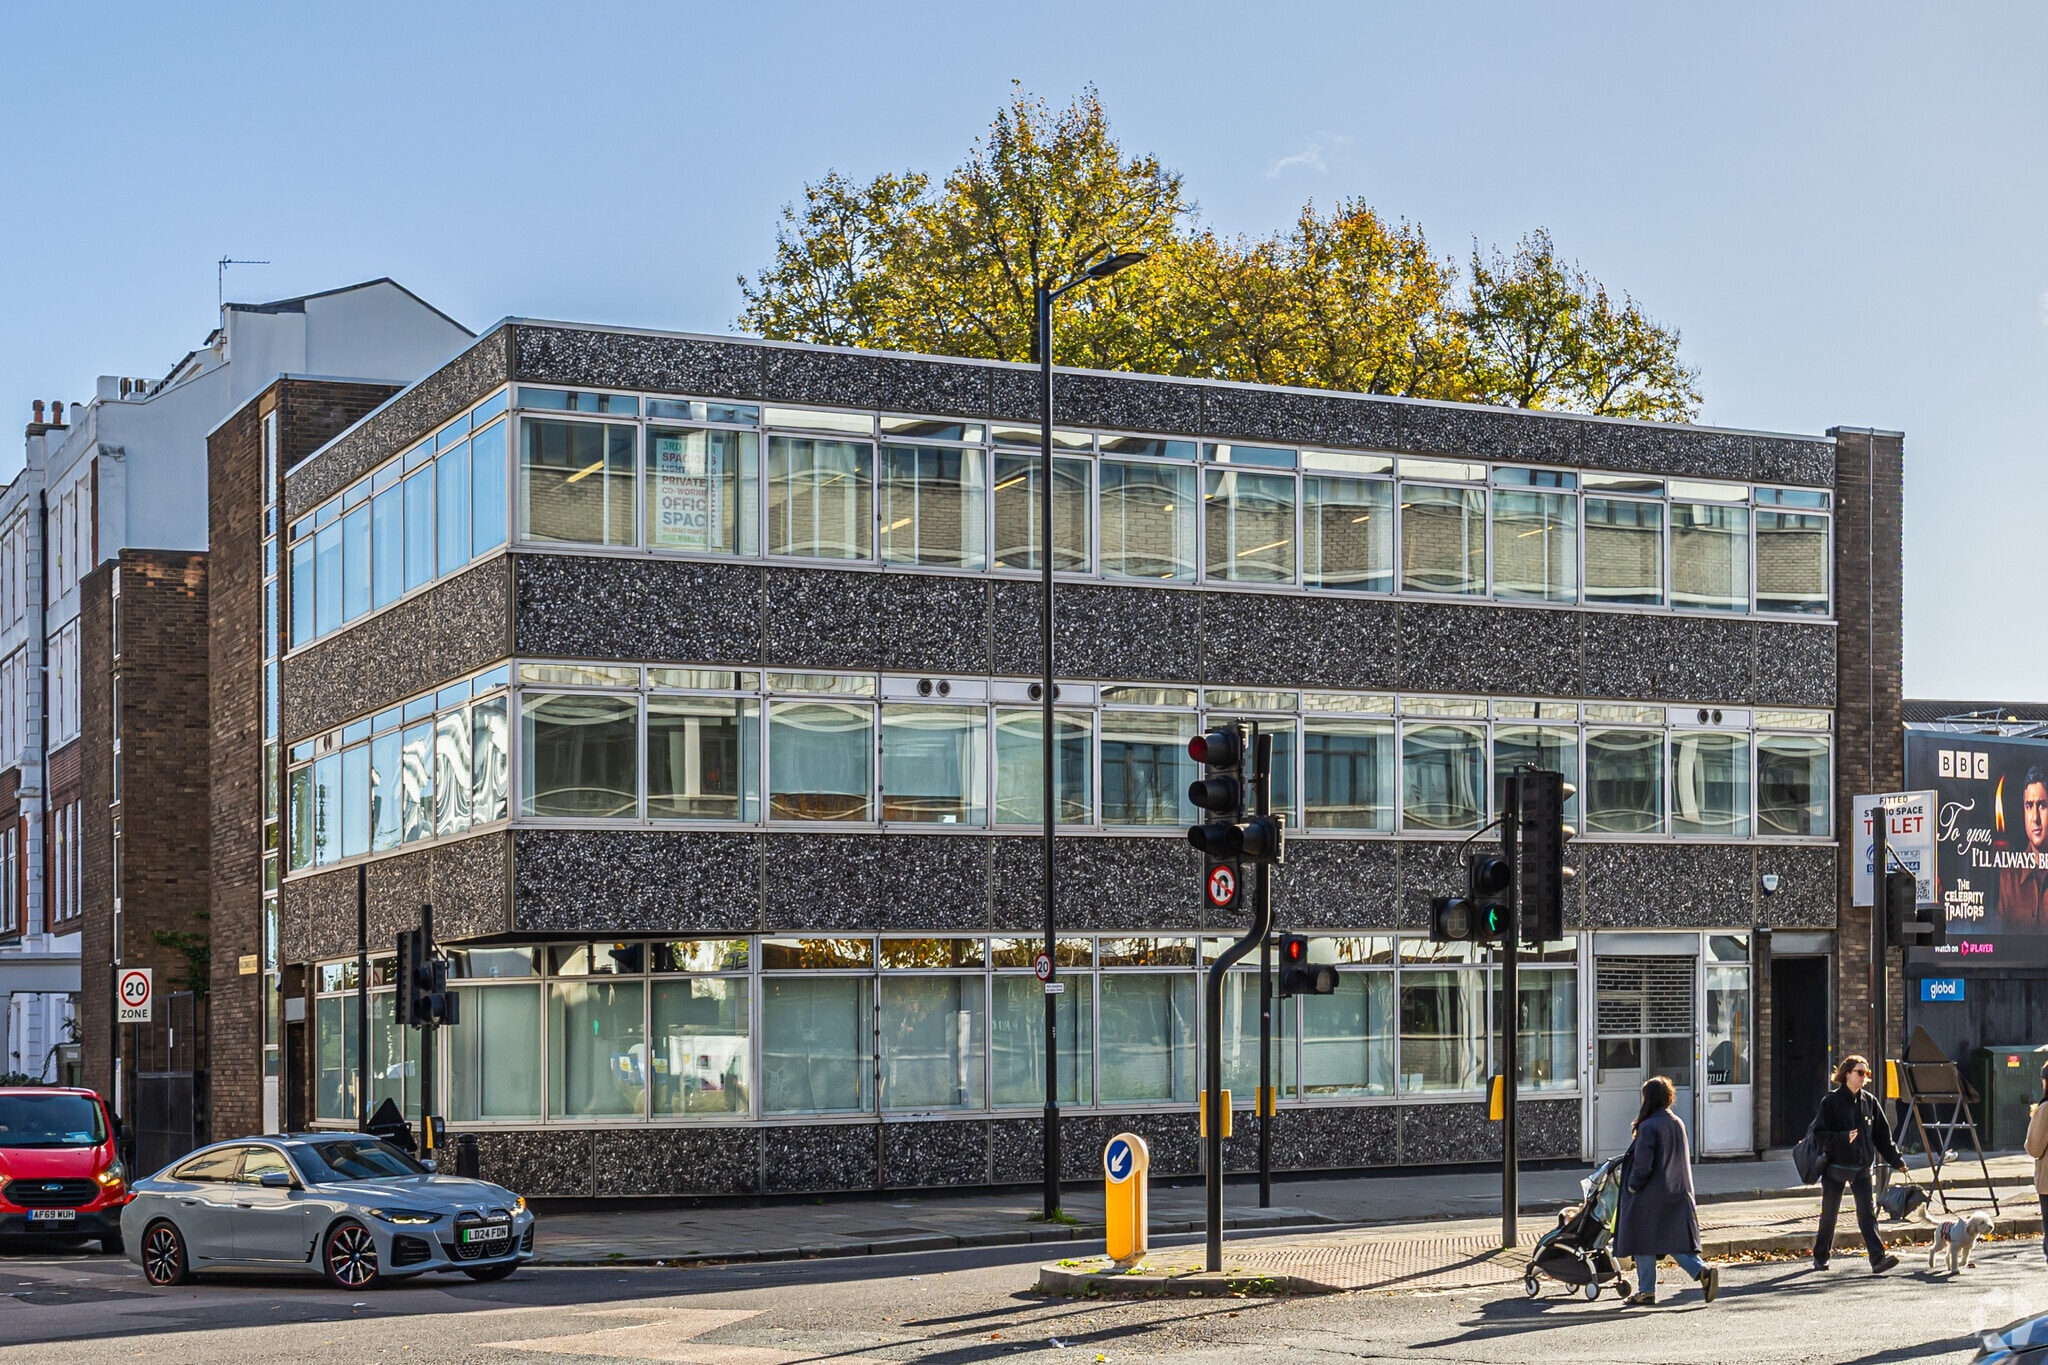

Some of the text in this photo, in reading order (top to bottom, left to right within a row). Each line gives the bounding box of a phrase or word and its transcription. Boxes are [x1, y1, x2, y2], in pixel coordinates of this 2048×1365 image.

[663, 441, 682, 451] 3RD
[662, 452, 717, 466] SPACIOS
[662, 475, 707, 487] PRIVATE
[1942, 756, 1986, 774] BBC
[1879, 795, 1909, 805] FITTED
[1864, 806, 1923, 818] STIO SPACE
[1891, 816, 1924, 835] LET
[1937, 798, 1993, 856] To you,
[1971, 847, 1992, 868] I'LL
[1993, 851, 2036, 869] ALWAYS
[1957, 878, 1970, 891] THE
[1944, 890, 1985, 904] CELEBRITY
[1944, 903, 1985, 922] TRAITORS
[1037, 961, 1049, 973] 20
[125, 981, 146, 997] 20
[1930, 981, 1956, 999] global
[121, 1008, 149, 1019] ZONE
[34, 1210, 74, 1219] AF69 WUH
[469, 1227, 506, 1240] LD24 FDN
